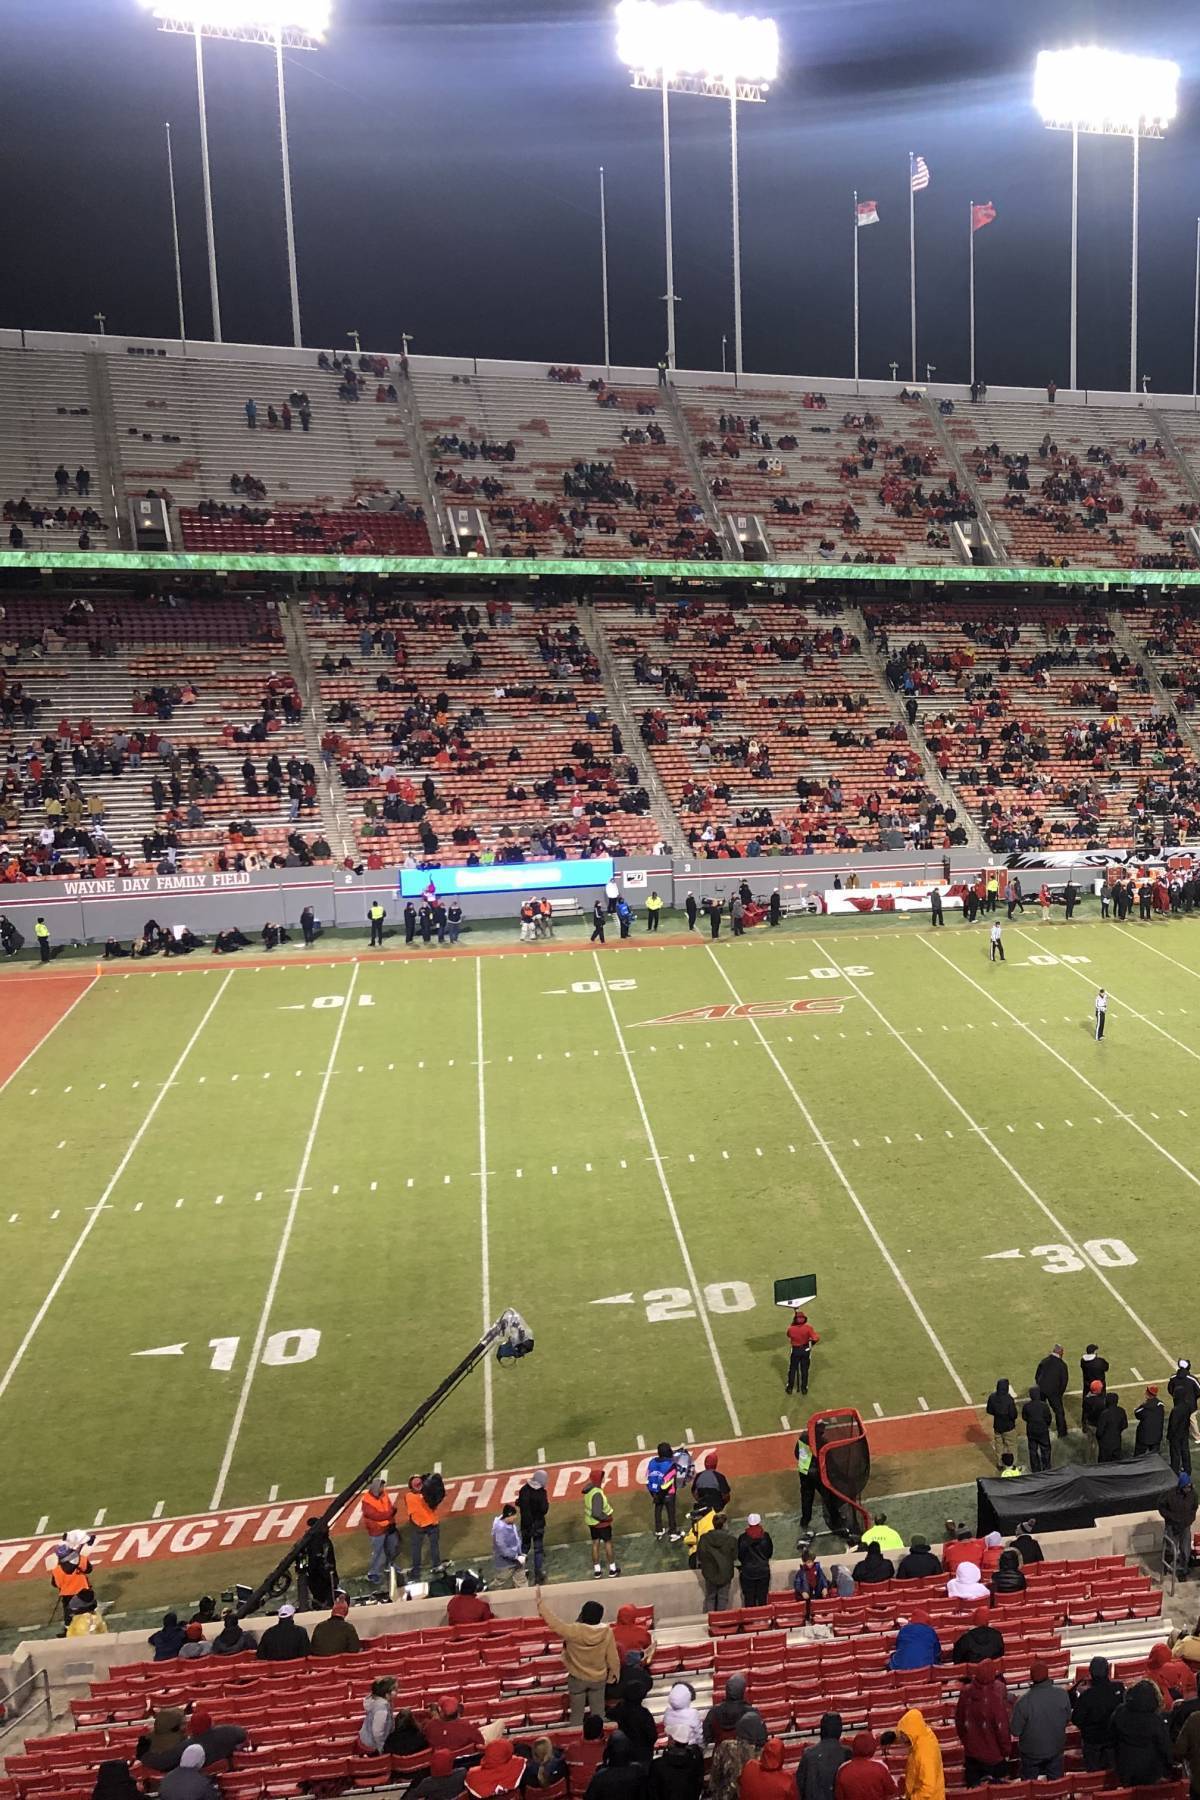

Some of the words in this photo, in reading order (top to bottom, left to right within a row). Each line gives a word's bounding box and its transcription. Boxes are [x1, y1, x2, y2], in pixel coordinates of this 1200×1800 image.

[64, 879, 116, 896] WAYNE
[122, 878, 151, 892] DAY
[156, 874, 207, 890] FAMILY
[212, 872, 251, 885] FIELD
[344, 874, 353, 884] 2
[1026, 953, 1093, 966] 40
[809, 965, 875, 980] 30
[568, 978, 638, 993] 20
[312, 994, 375, 1009] 10
[637, 996, 851, 1025] ACC
[1030, 1238, 1138, 1273] 30
[643, 1281, 756, 1322] 20
[208, 1328, 321, 1371] 10
[421, 1473, 542, 1512] HE
[552, 1447, 717, 1498] PA
